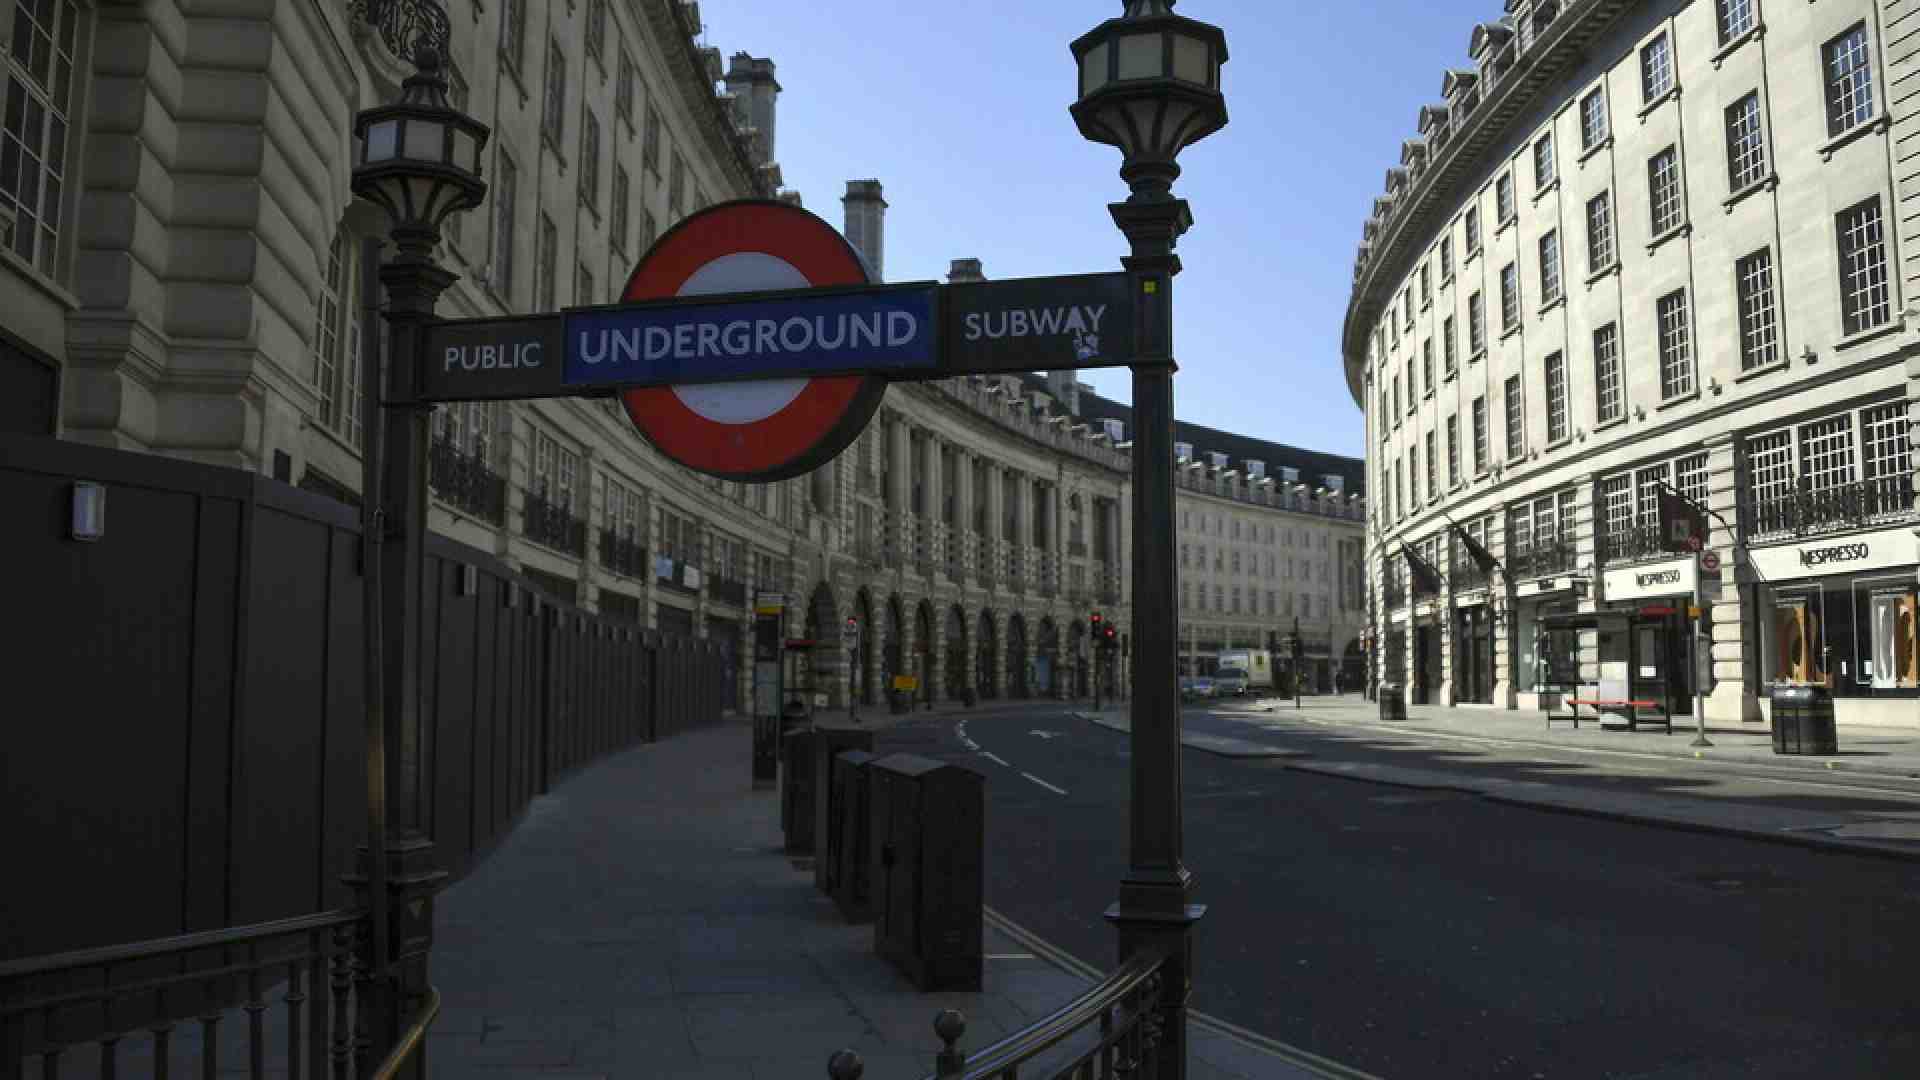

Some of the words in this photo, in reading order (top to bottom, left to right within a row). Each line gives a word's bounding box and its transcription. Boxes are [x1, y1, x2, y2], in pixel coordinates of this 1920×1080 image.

[443, 343, 541, 373] PUBLIC
[578, 309, 918, 365] UNDERGROUND
[963, 303, 1107, 341] SUBWAY
[1799, 542, 1869, 567] NESPRESSO
